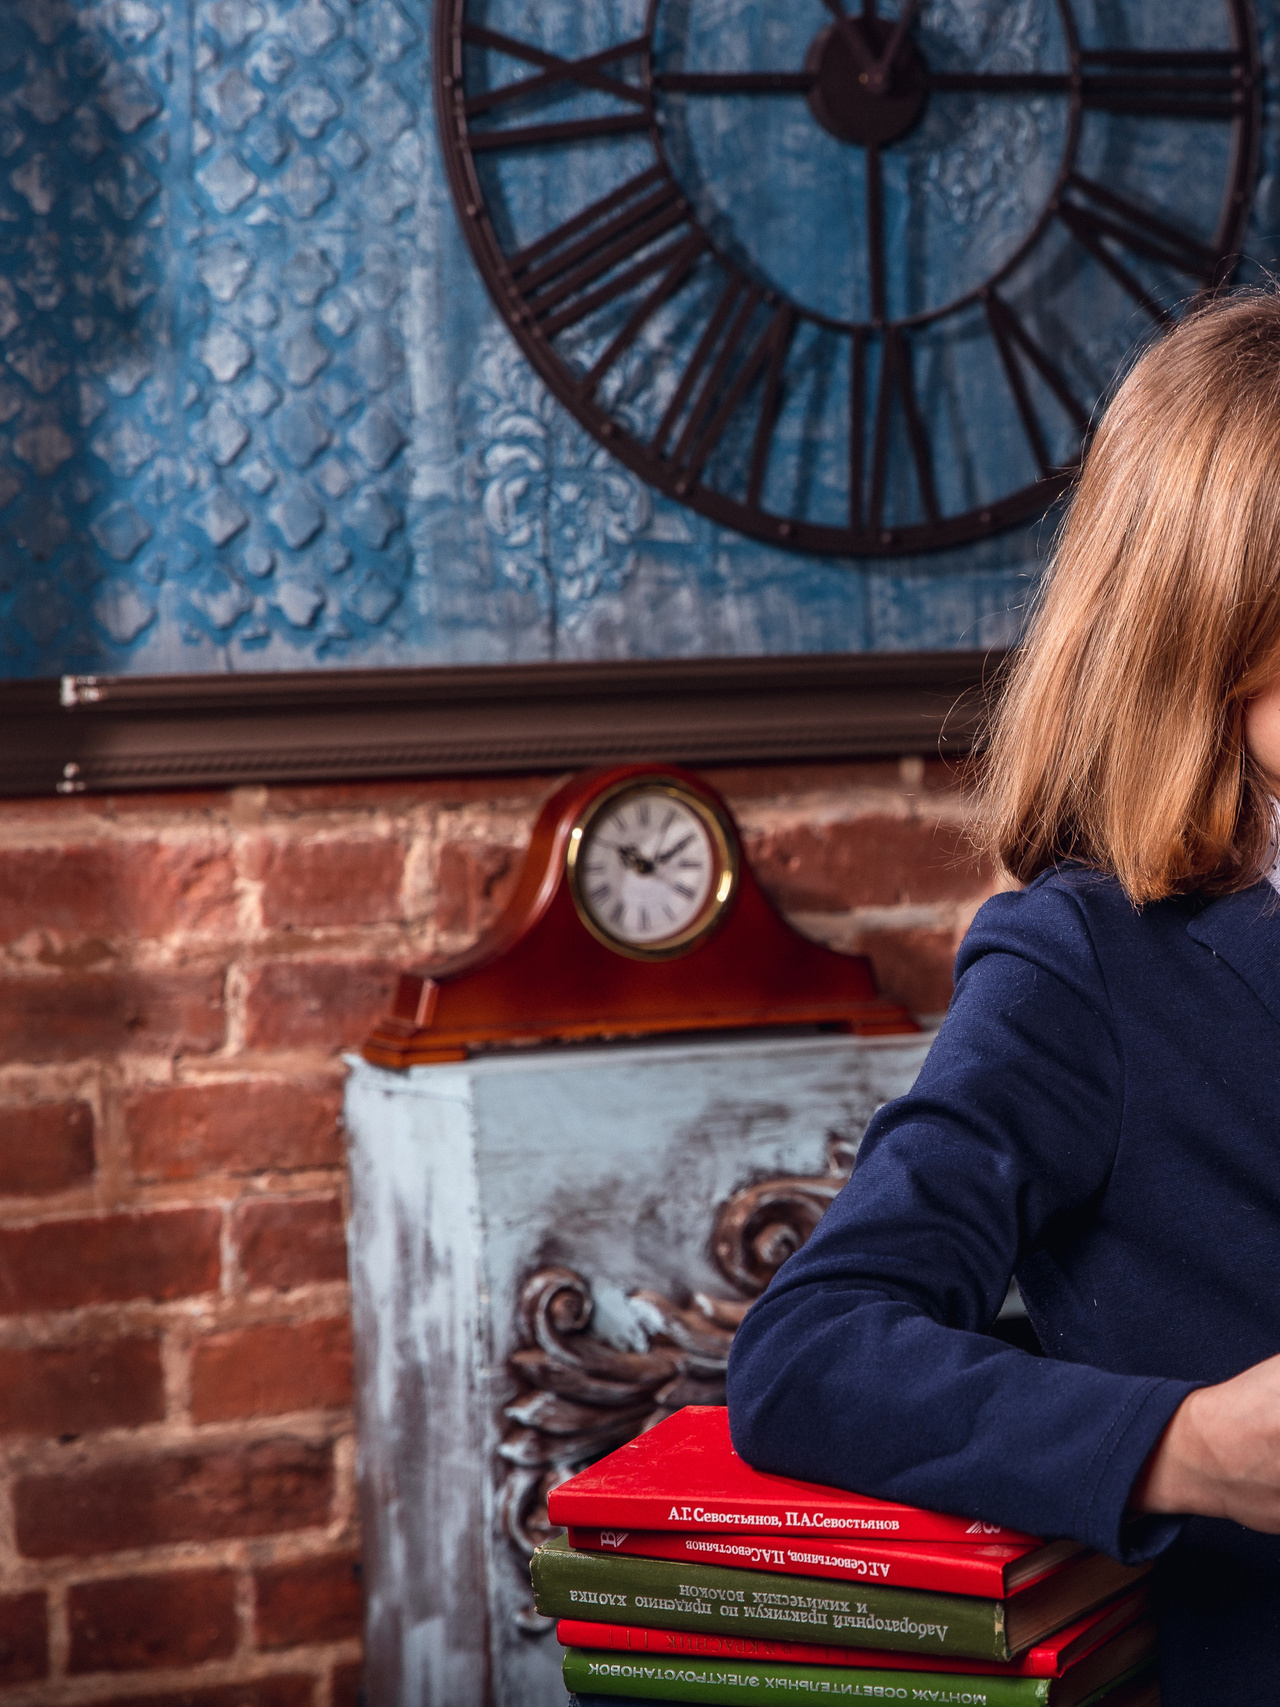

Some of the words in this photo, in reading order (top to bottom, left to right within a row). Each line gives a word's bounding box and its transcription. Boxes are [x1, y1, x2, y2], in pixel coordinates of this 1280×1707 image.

[569, 1589, 628, 1607] хлопка
[678, 1583, 746, 1603] волокон
[752, 1591, 851, 1614] химических
[634, 1597, 712, 1615] прядению
[720, 1604, 740, 1617] по
[743, 1604, 828, 1626] практикум
[832, 1614, 949, 1642] Лабораторный
[588, 1663, 760, 1688] ЭЛЕКТРОУСТАНОВОК
[764, 1677, 908, 1699] ОСВЕТИТЕЛЬНЫХ
[911, 1689, 988, 1705] МОНТАЖ
